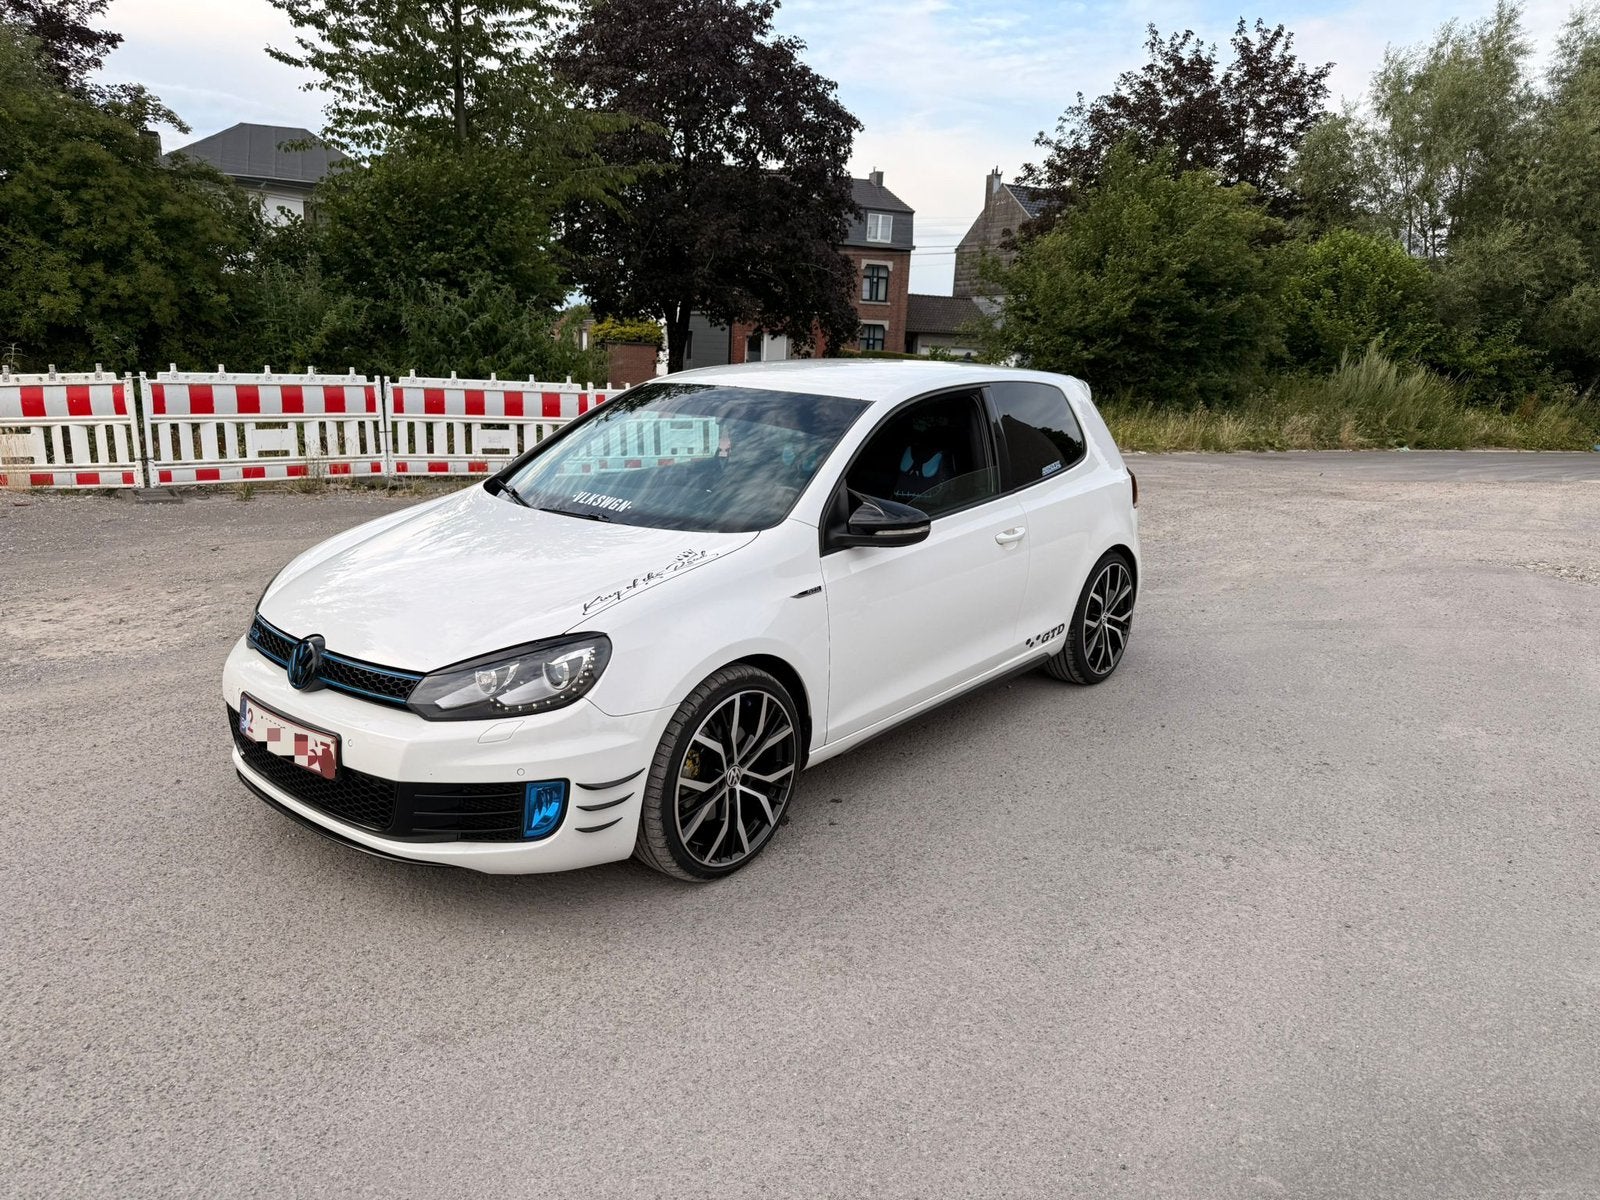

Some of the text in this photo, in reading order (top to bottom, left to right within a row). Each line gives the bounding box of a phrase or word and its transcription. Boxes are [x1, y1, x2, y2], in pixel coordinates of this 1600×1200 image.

[583, 590, 623, 613] King
[626, 578, 639, 589] of
[1042, 623, 1065, 643] GTD
